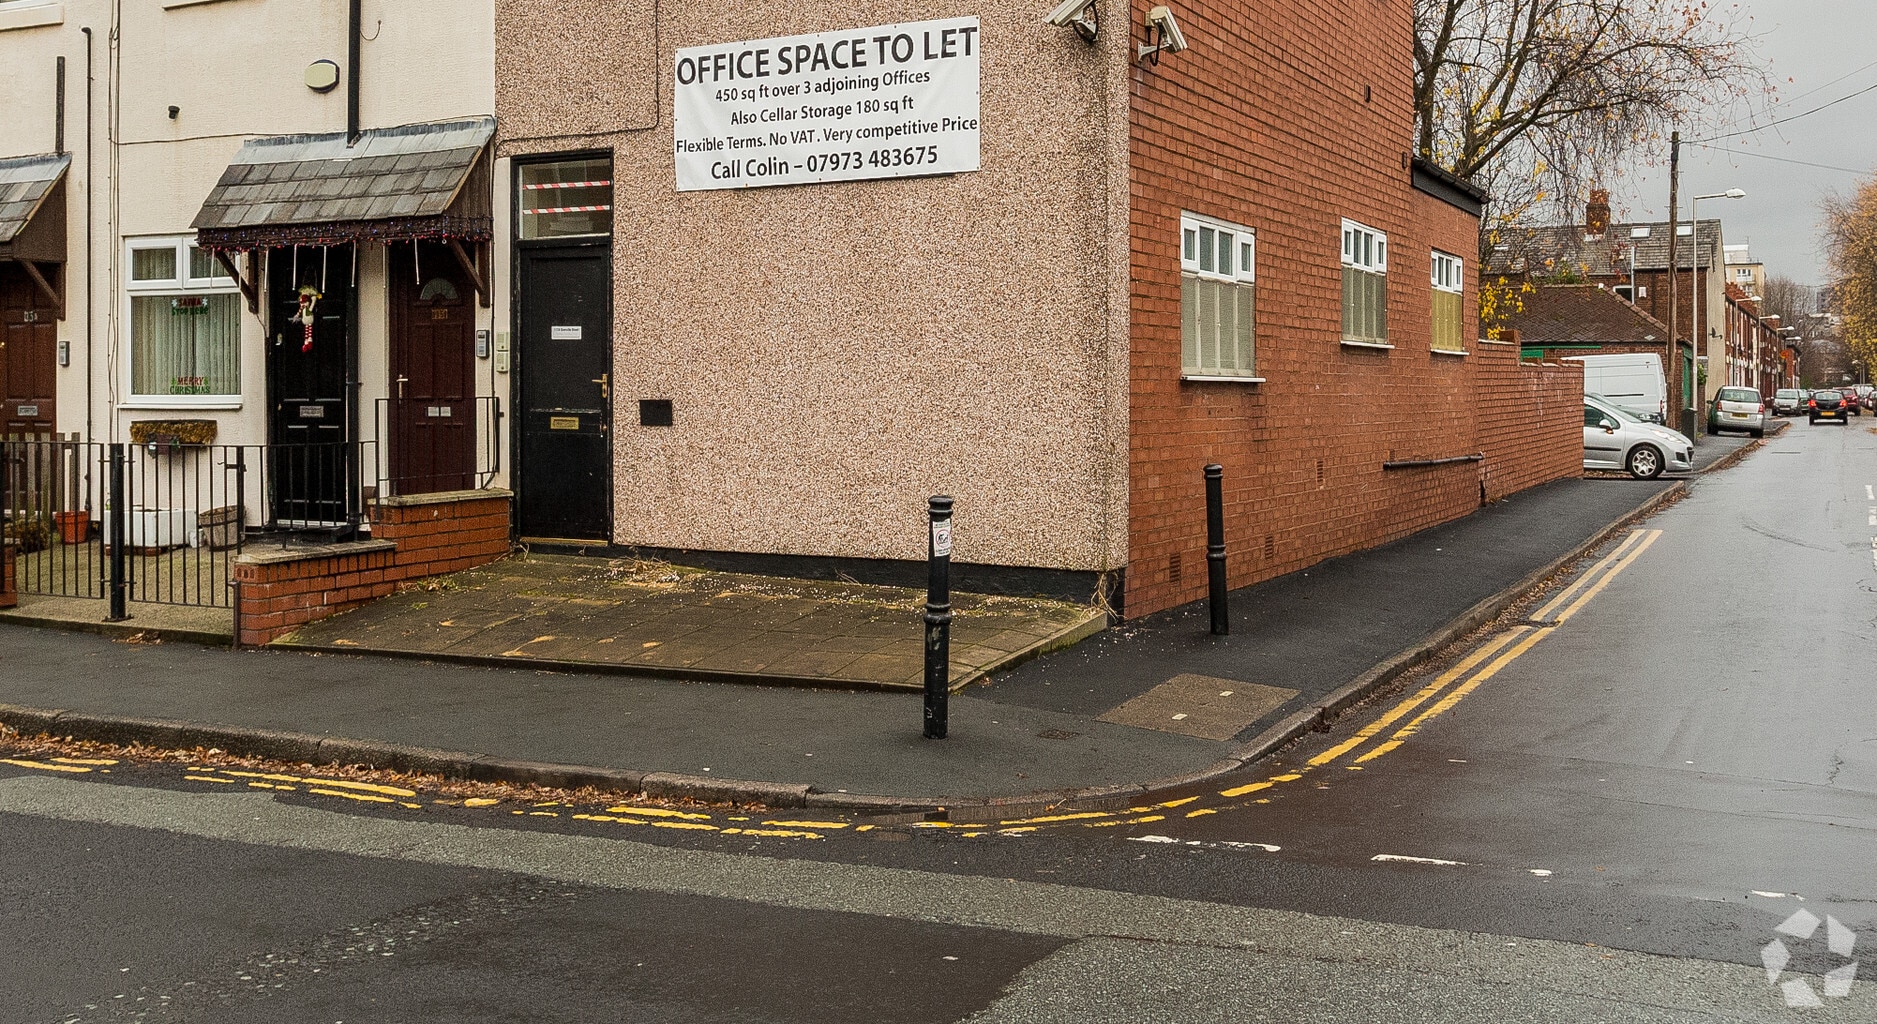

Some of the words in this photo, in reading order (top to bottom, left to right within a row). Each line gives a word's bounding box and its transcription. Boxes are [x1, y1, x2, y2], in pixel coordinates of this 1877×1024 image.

[677, 48, 770, 85] OFFICE
[777, 37, 867, 76] SPACE
[872, 33, 914, 66] TO
[923, 26, 978, 61] LET
[715, 87, 739, 102] 450
[741, 89, 756, 103] sq
[758, 83, 770, 99] ft
[771, 84, 801, 98] over
[803, 80, 811, 95] 3
[814, 74, 879, 94] adjoining
[882, 69, 931, 86] Offices
[730, 110, 758, 126] Also
[759, 106, 798, 123] Cellar
[800, 104, 852, 120] Storage
[856, 98, 880, 115] 180
[883, 99, 899, 115] sq
[901, 94, 914, 110] ft
[676, 136, 724, 154] Flexible
[726, 135, 767, 150] Terms.
[769, 131, 788, 146] No
[822, 126, 853, 144] Very
[855, 119, 939, 141] competitive
[941, 117, 978, 132] Price
[711, 158, 741, 180] Call
[745, 156, 789, 177] Colin
[806, 151, 864, 173] 07973
[868, 144, 938, 168] 483675
[177, 376, 204, 386] MERRY
